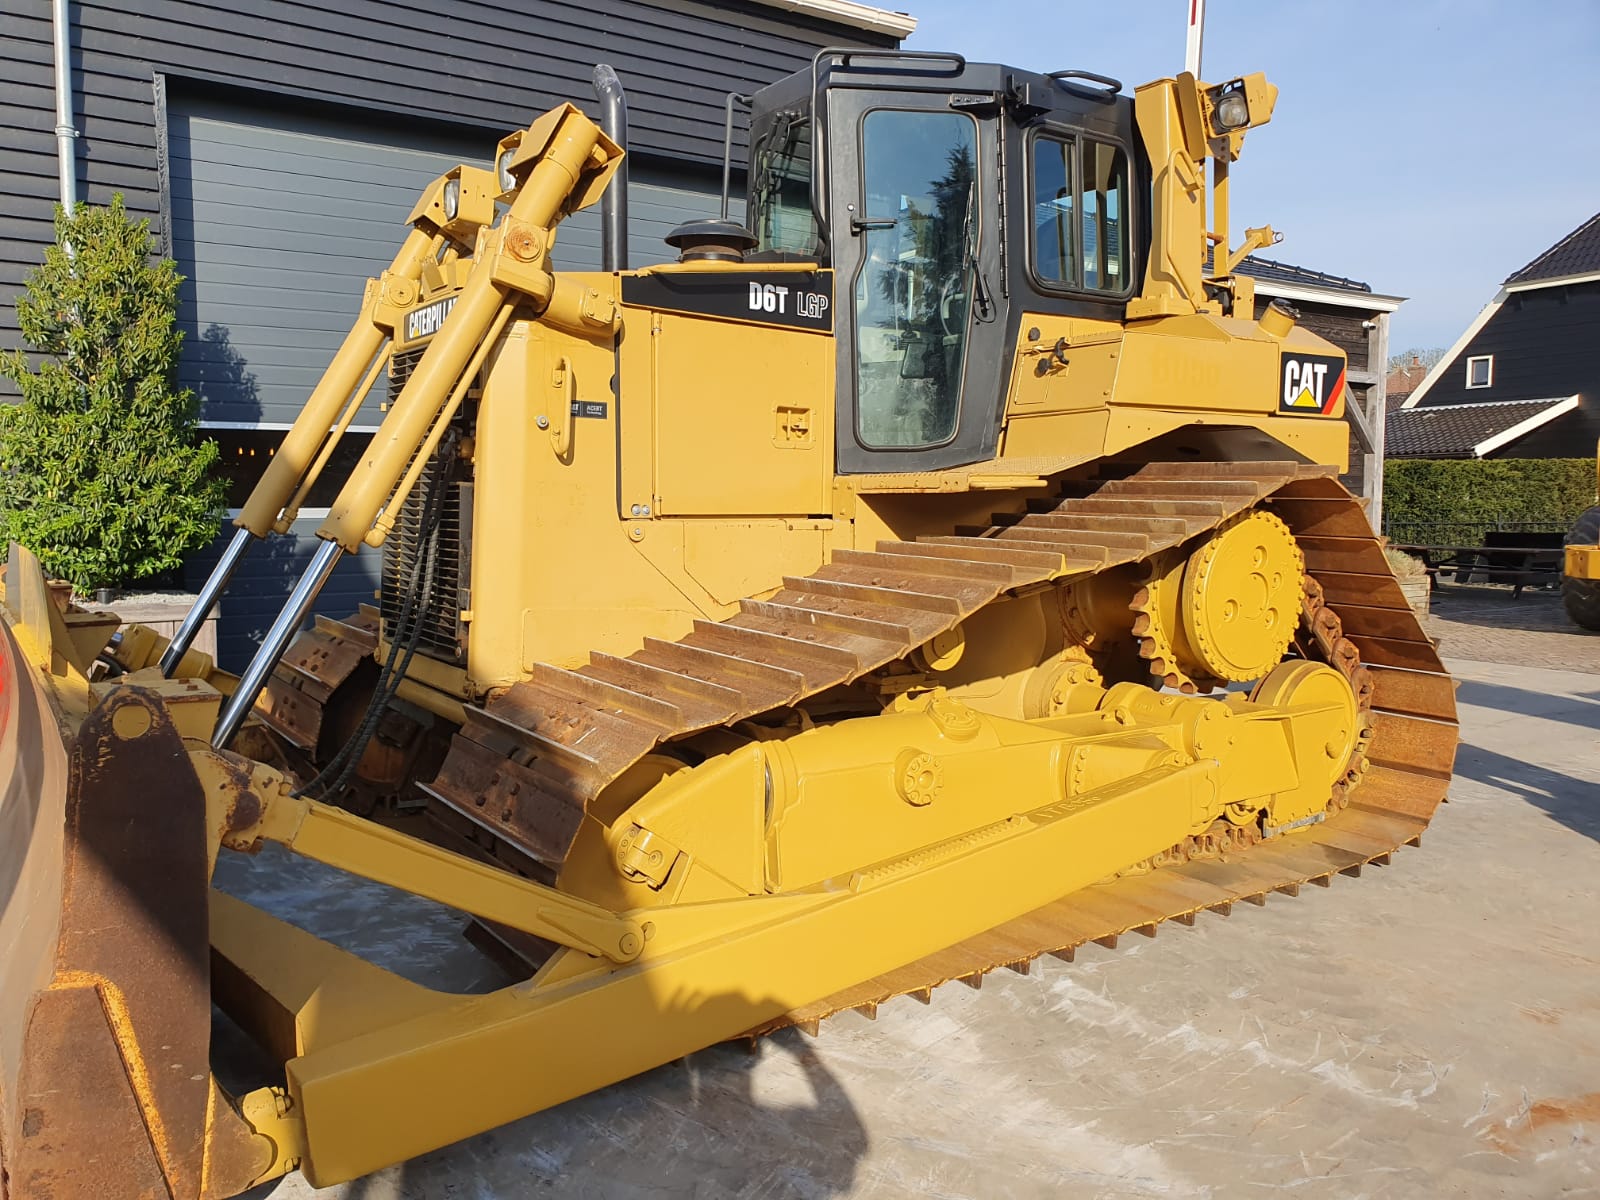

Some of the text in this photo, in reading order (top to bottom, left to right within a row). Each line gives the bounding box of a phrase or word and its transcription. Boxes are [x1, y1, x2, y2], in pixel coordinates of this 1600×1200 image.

[409, 297, 458, 339] CATERPILL
[749, 281, 829, 319] D6T LGP
[1284, 359, 1328, 409] CAT
